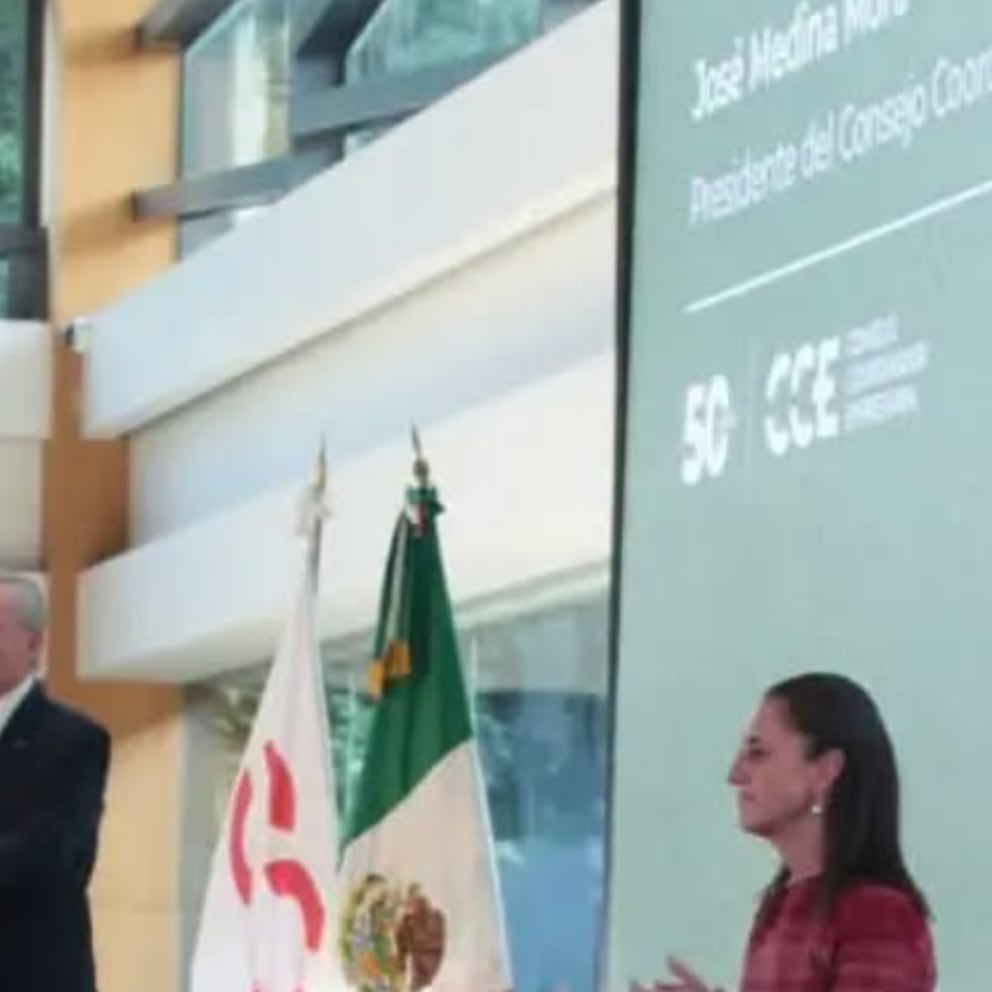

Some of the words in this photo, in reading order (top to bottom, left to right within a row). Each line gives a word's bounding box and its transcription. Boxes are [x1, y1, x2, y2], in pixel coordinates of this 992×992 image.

[691, 35, 744, 121] José
[748, 1, 837, 91] Medina
[689, 147, 797, 226] Presidente
[801, 109, 834, 178] del
[838, 72, 927, 162] Consejo
[765, 336, 840, 455] CCE
